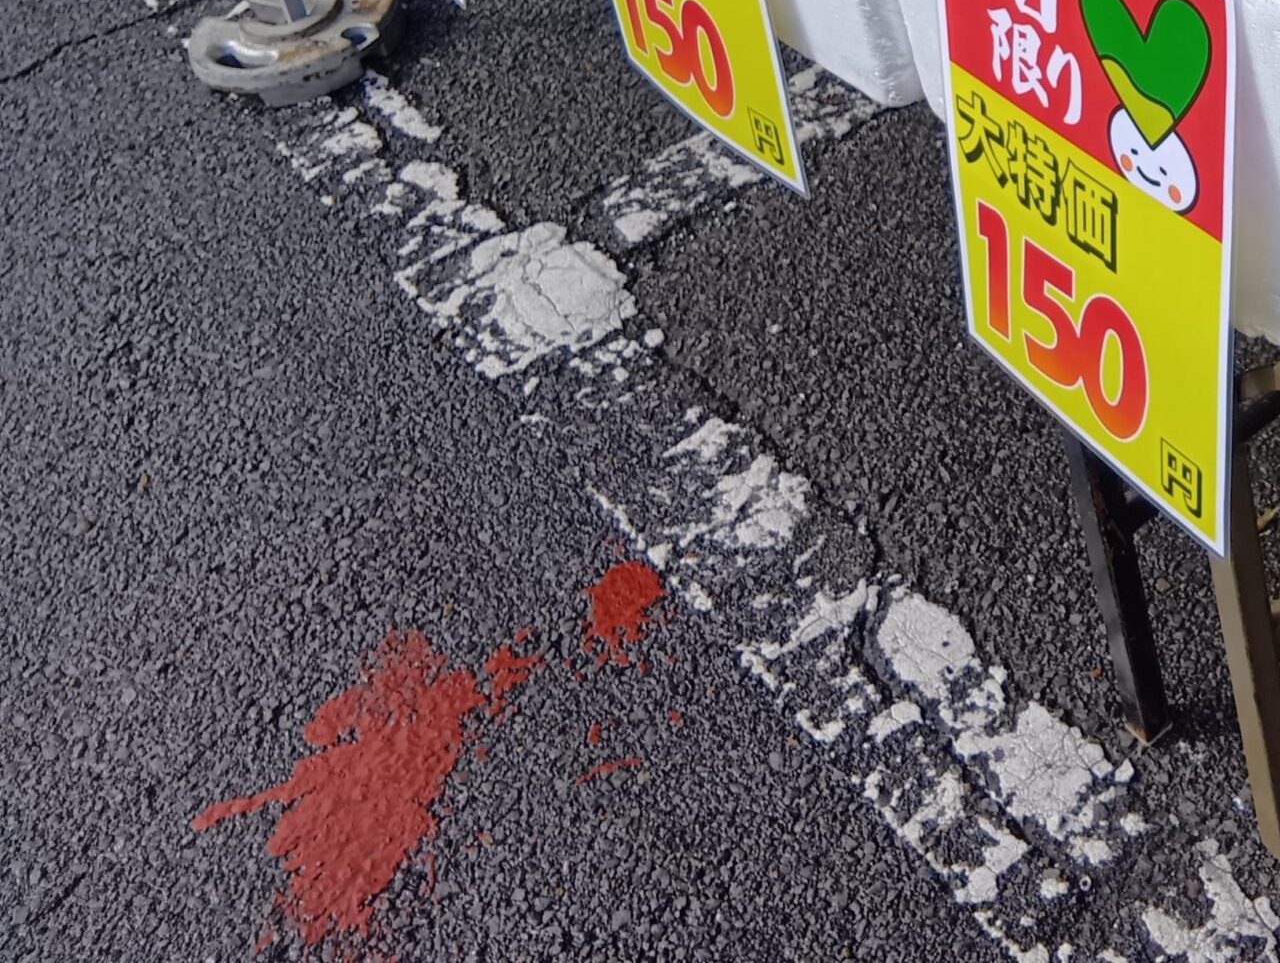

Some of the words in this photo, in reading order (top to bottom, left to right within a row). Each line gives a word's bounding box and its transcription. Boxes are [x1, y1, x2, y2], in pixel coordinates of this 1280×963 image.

[987, 6, 1083, 127] 限り
[748, 106, 786, 167] 円
[956, 89, 1120, 274] 大特価
[975, 197, 1149, 444] 150
[1160, 437, 1203, 520] 円
